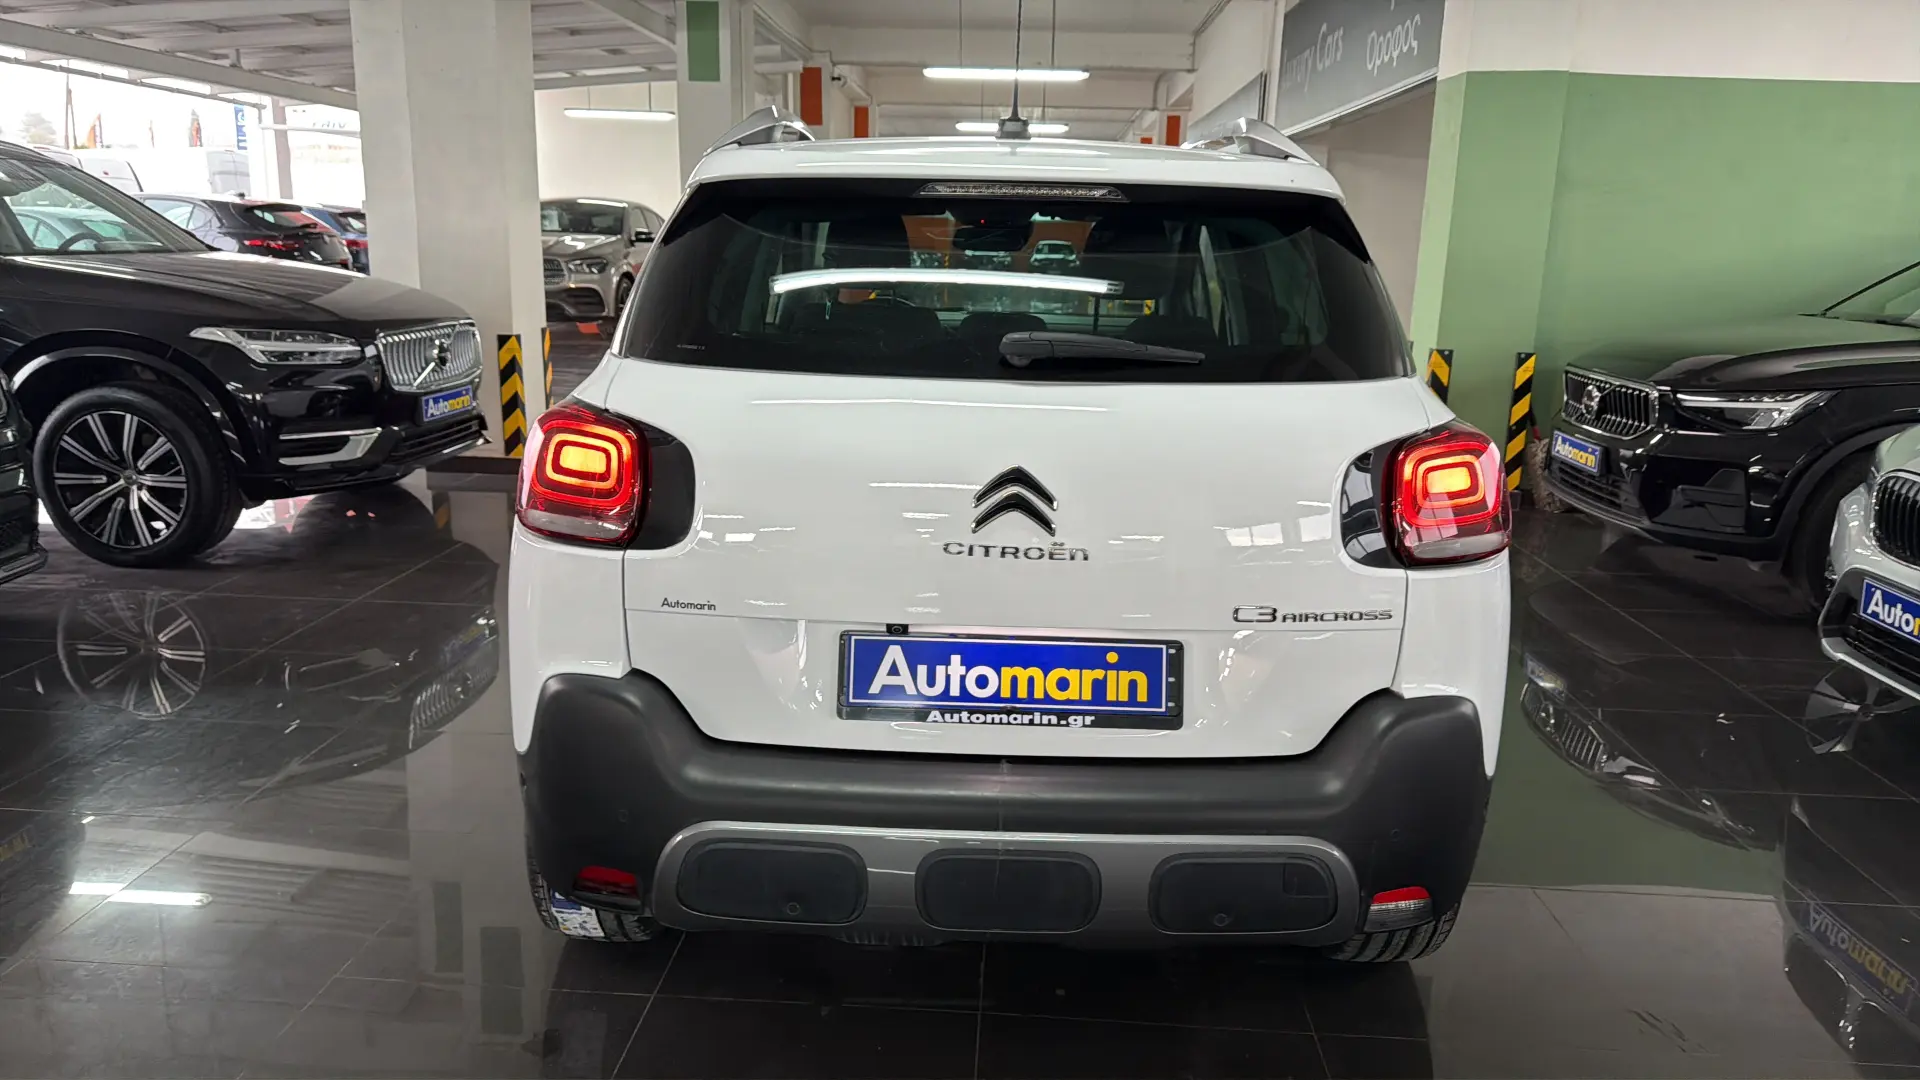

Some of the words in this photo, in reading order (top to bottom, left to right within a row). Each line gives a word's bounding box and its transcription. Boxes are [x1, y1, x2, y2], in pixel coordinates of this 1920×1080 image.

[1316, 22, 1344, 71] Cars
[427, 390, 471, 418] Automarin
[1555, 435, 1596, 468] Automarin
[661, 597, 716, 611] Automarin
[1233, 605, 1278, 623] C3
[1281, 609, 1393, 623] AIRCROSS
[867, 644, 1149, 702] Automarin
[926, 710, 1096, 728] Automarin.gr
